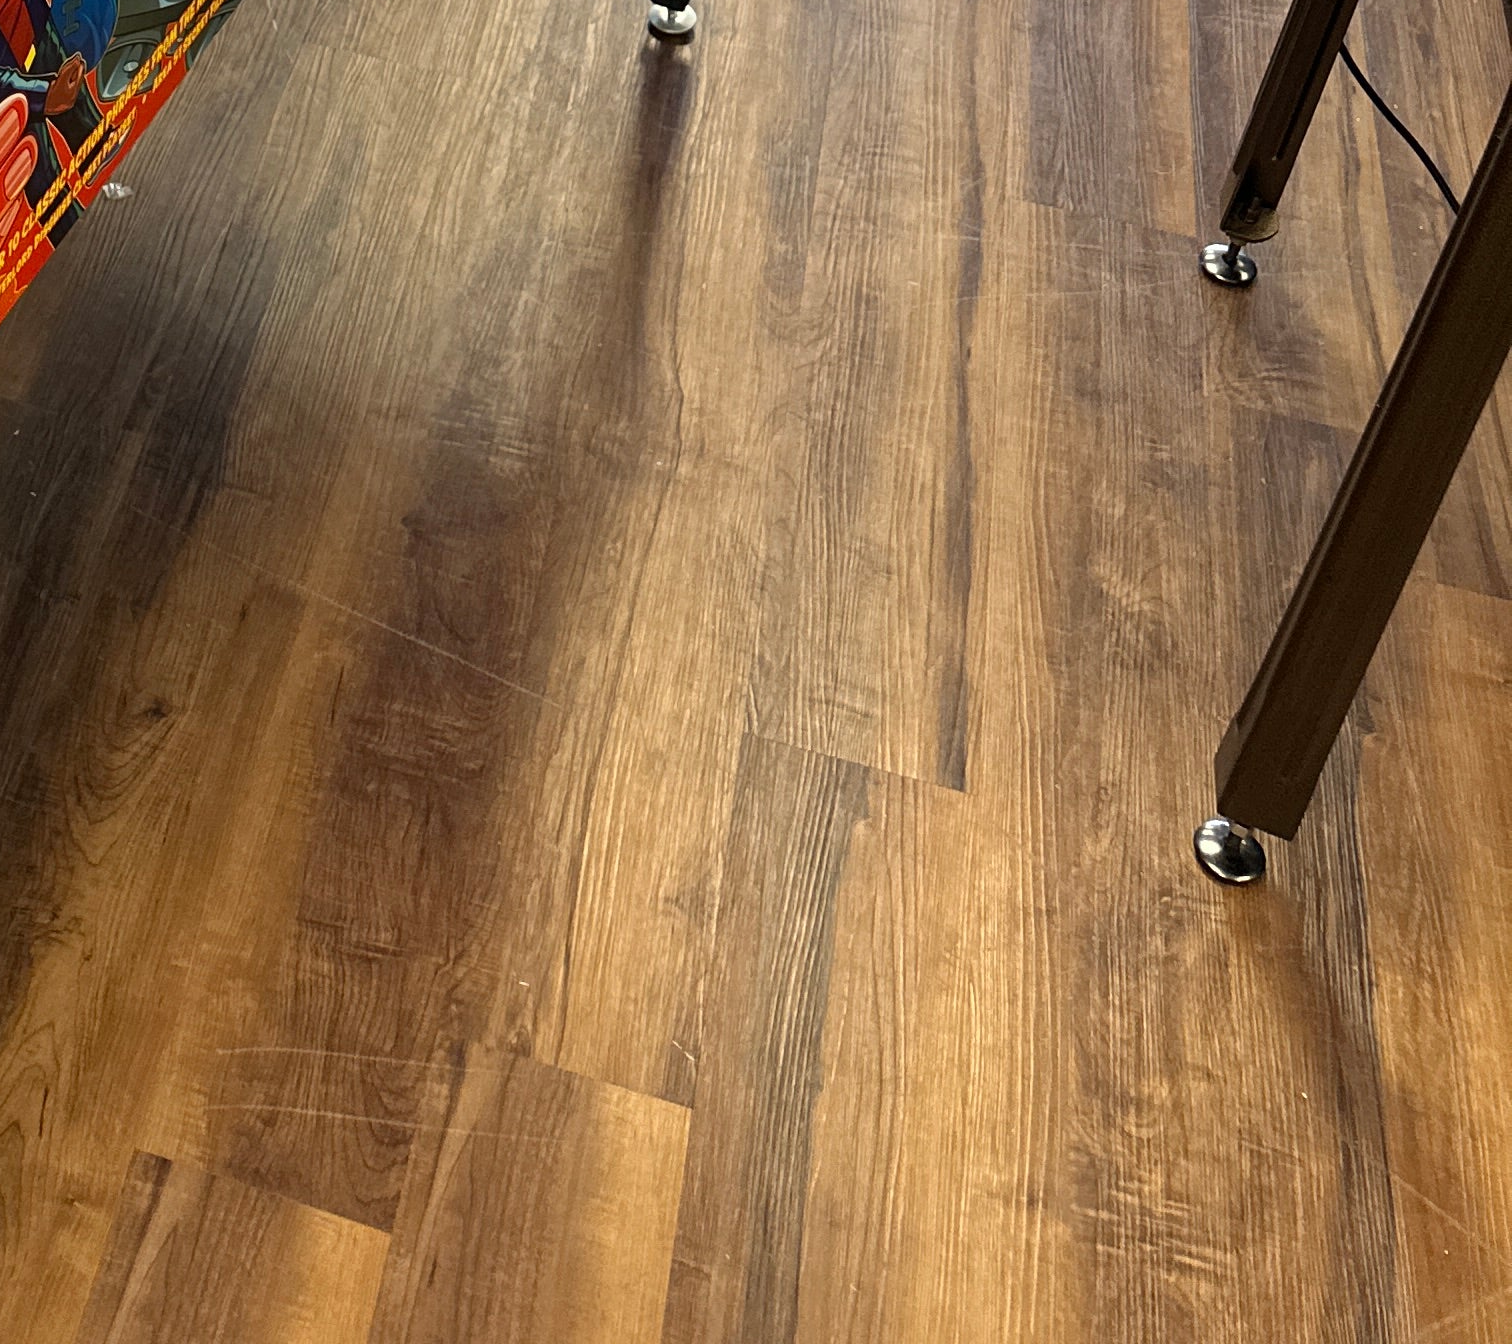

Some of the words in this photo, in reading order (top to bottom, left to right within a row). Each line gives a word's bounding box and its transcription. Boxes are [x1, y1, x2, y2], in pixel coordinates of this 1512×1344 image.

[7, 230, 20, 257] 10
[21, 168, 67, 239] CLASSIC
[68, 119, 104, 176] ACTION
[105, 62, 150, 129] PHRASES
[151, 22, 178, 70] FROM
[33, 189, 73, 250] DISGUISE
[73, 154, 103, 198] CLOSET
[103, 106, 137, 156] PLAYSET
[153, 62, 173, 94] AREA
[182, 9, 210, 54] SECRET
